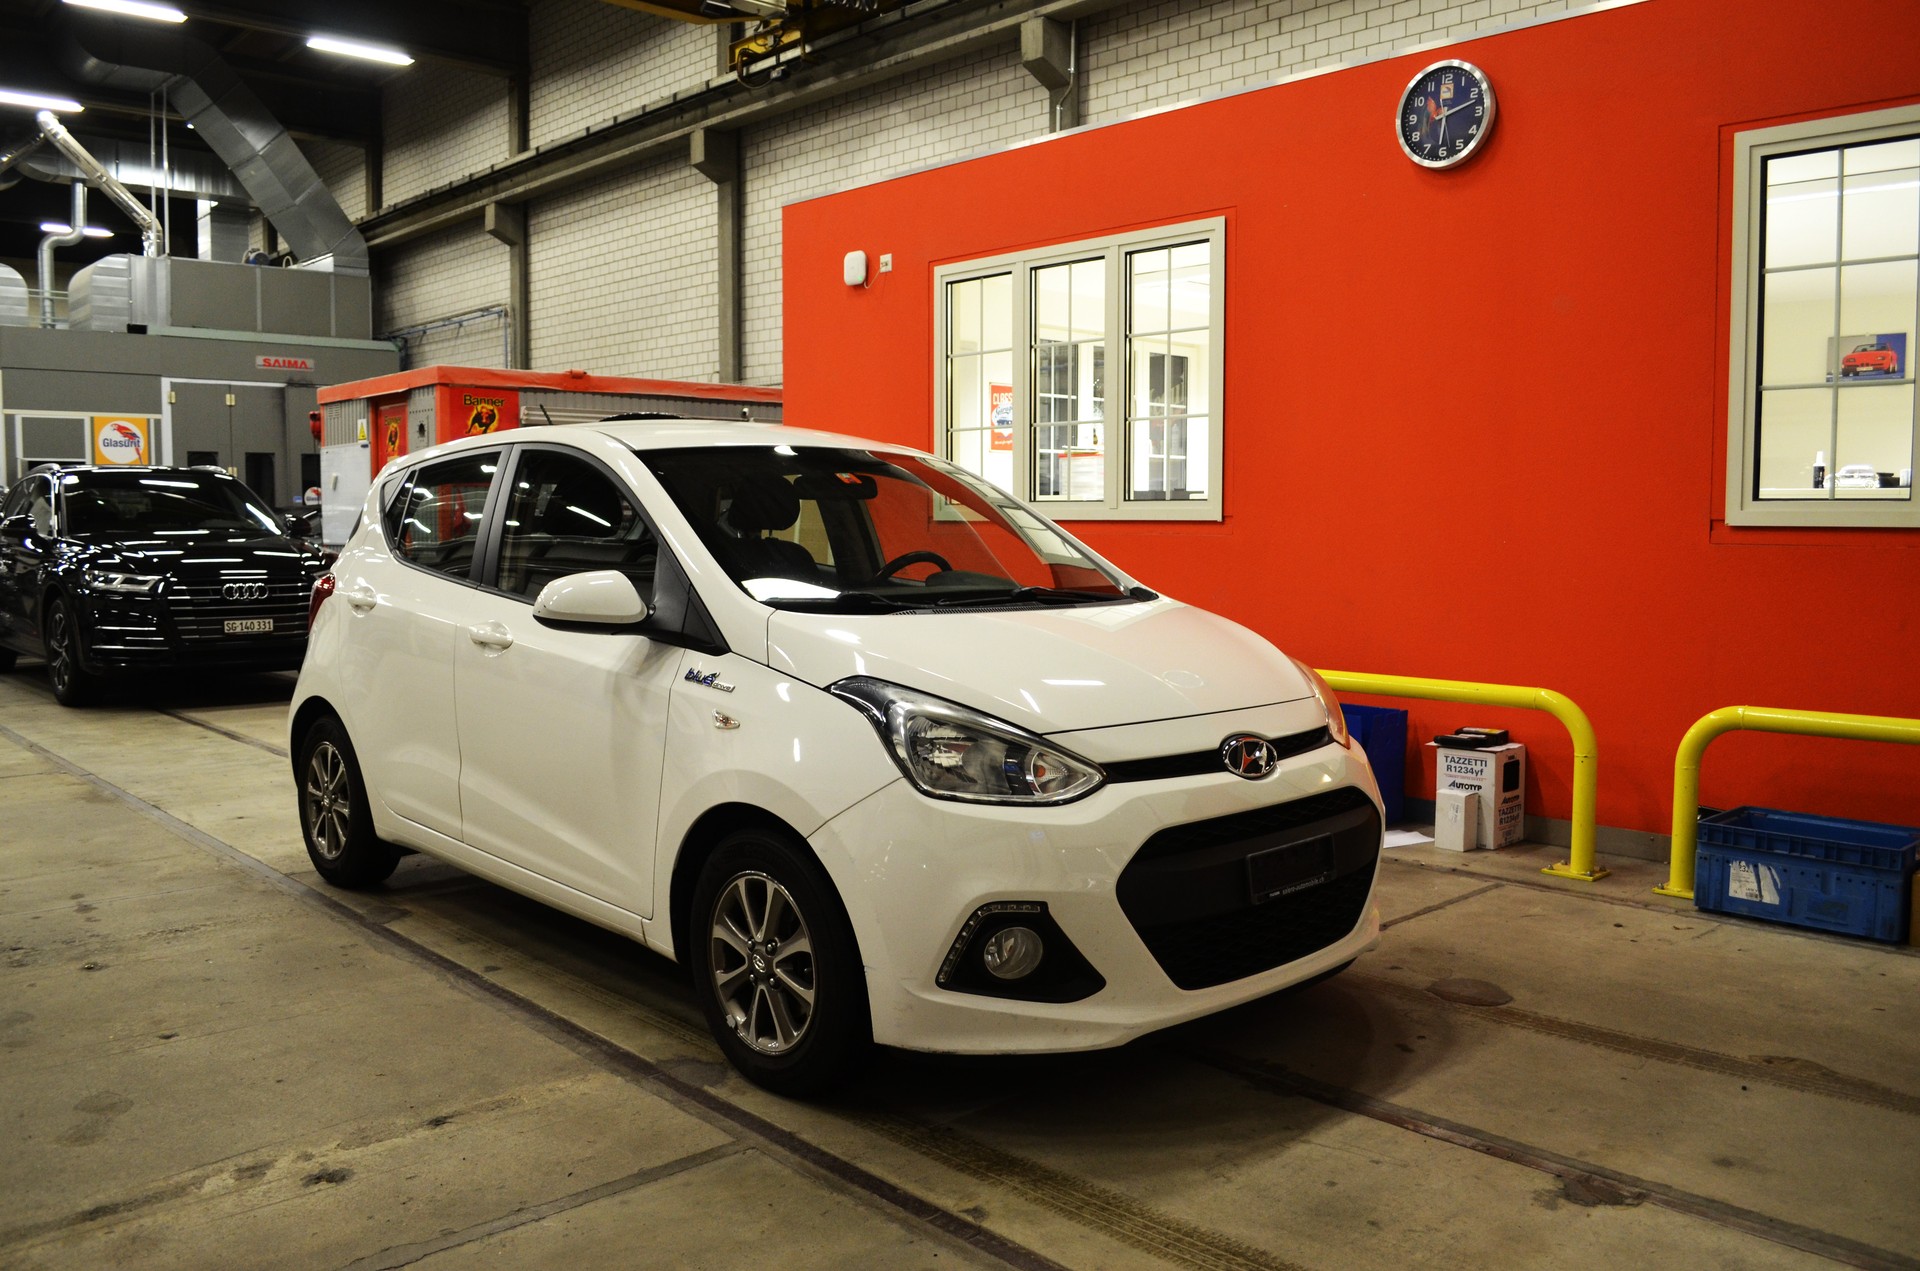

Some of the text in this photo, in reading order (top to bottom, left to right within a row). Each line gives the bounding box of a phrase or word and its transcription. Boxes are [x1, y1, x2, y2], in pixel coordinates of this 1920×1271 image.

[1441, 74, 1453, 84] 12
[1461, 76, 1465, 87] 1
[1427, 81, 1435, 92] 11
[1470, 87, 1479, 99] 2
[1414, 96, 1425, 108] 10
[1474, 105, 1483, 117] 3
[1409, 114, 1418, 125] 9
[1468, 124, 1477, 135] 4
[1411, 131, 1420, 142] 8
[1423, 143, 1432, 154] 7
[1455, 139, 1464, 150] 5
[1438, 146, 1447, 157] 6
[262, 358, 308, 369] SAIMA
[463, 393, 505, 407] Banner
[102, 438, 141, 448] Glasurit
[256, 621, 272, 630] 331
[684, 667, 714, 688] blue
[1444, 756, 1488, 767] TAZZETTI
[1447, 765, 1484, 777] R1234yf
